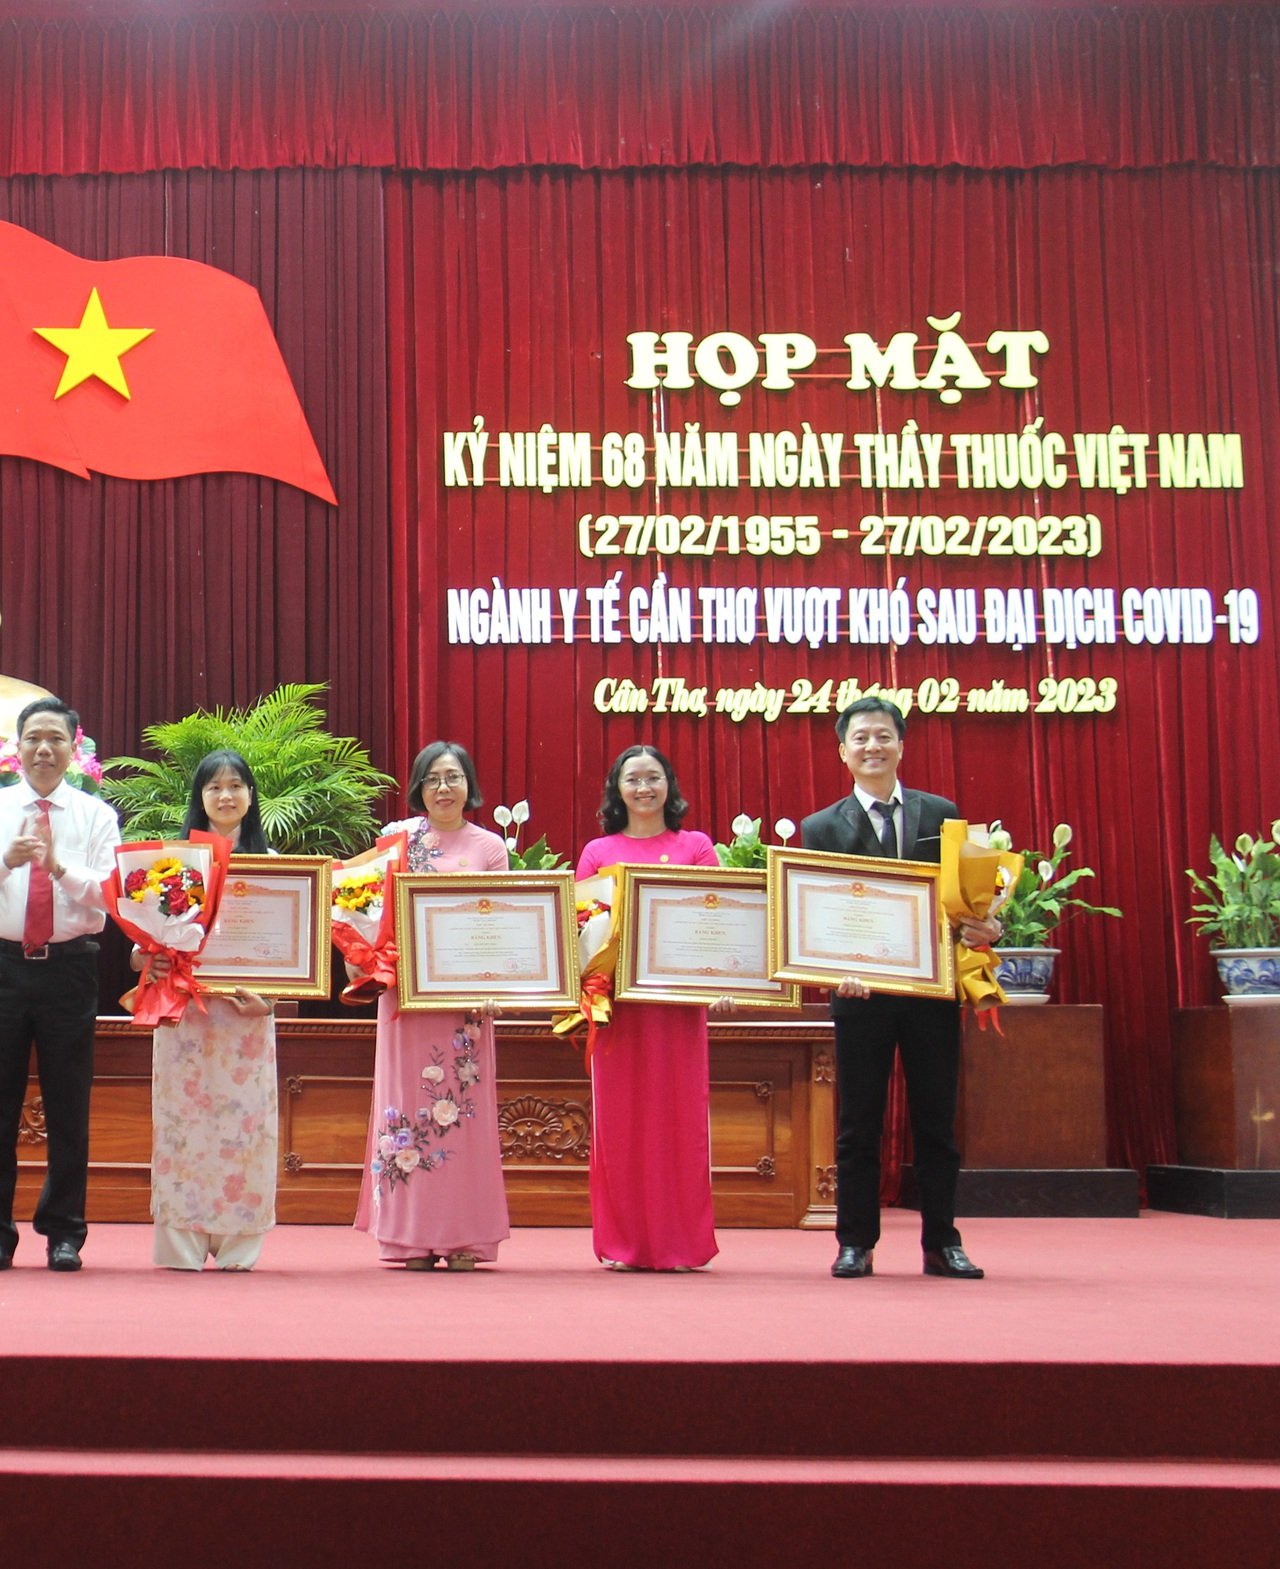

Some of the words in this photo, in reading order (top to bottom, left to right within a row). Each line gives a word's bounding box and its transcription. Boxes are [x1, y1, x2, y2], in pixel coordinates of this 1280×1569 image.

[626, 331, 817, 406] HỌP
[843, 311, 1050, 405] MẶT
[443, 415, 489, 487] KỶ
[498, 423, 592, 493] NIỆM
[601, 432, 646, 488] 68
[655, 422, 740, 488] NĂM
[749, 422, 844, 488] NGÀY
[854, 419, 944, 488] THẦY
[950, 417, 1068, 489] THUỐC
[1073, 424, 1150, 494] VIỆT
[1157, 433, 1245, 488] NAM
[578, 514, 820, 558] (27/02/1955
[860, 514, 1103, 558] 27/02/2023)
[447, 576, 552, 644] NGÀNH
[558, 588, 578, 643] Y
[585, 571, 623, 643] TẾ
[629, 572, 692, 643] CẦN
[698, 588, 758, 644] THƠ
[764, 587, 841, 649] VƯỢT
[848, 576, 910, 646] KHÓ
[916, 587, 977, 645] SAU
[984, 587, 1037, 651] ĐẠI
[1043, 587, 1116, 649] DỊCH
[1122, 587, 1259, 645] COVID-19
[715, 682, 785, 722] ngày
[786, 678, 834, 713] 24
[918, 678, 960, 713] 02
[967, 680, 1029, 713] năm
[1034, 677, 1118, 713] 2023
